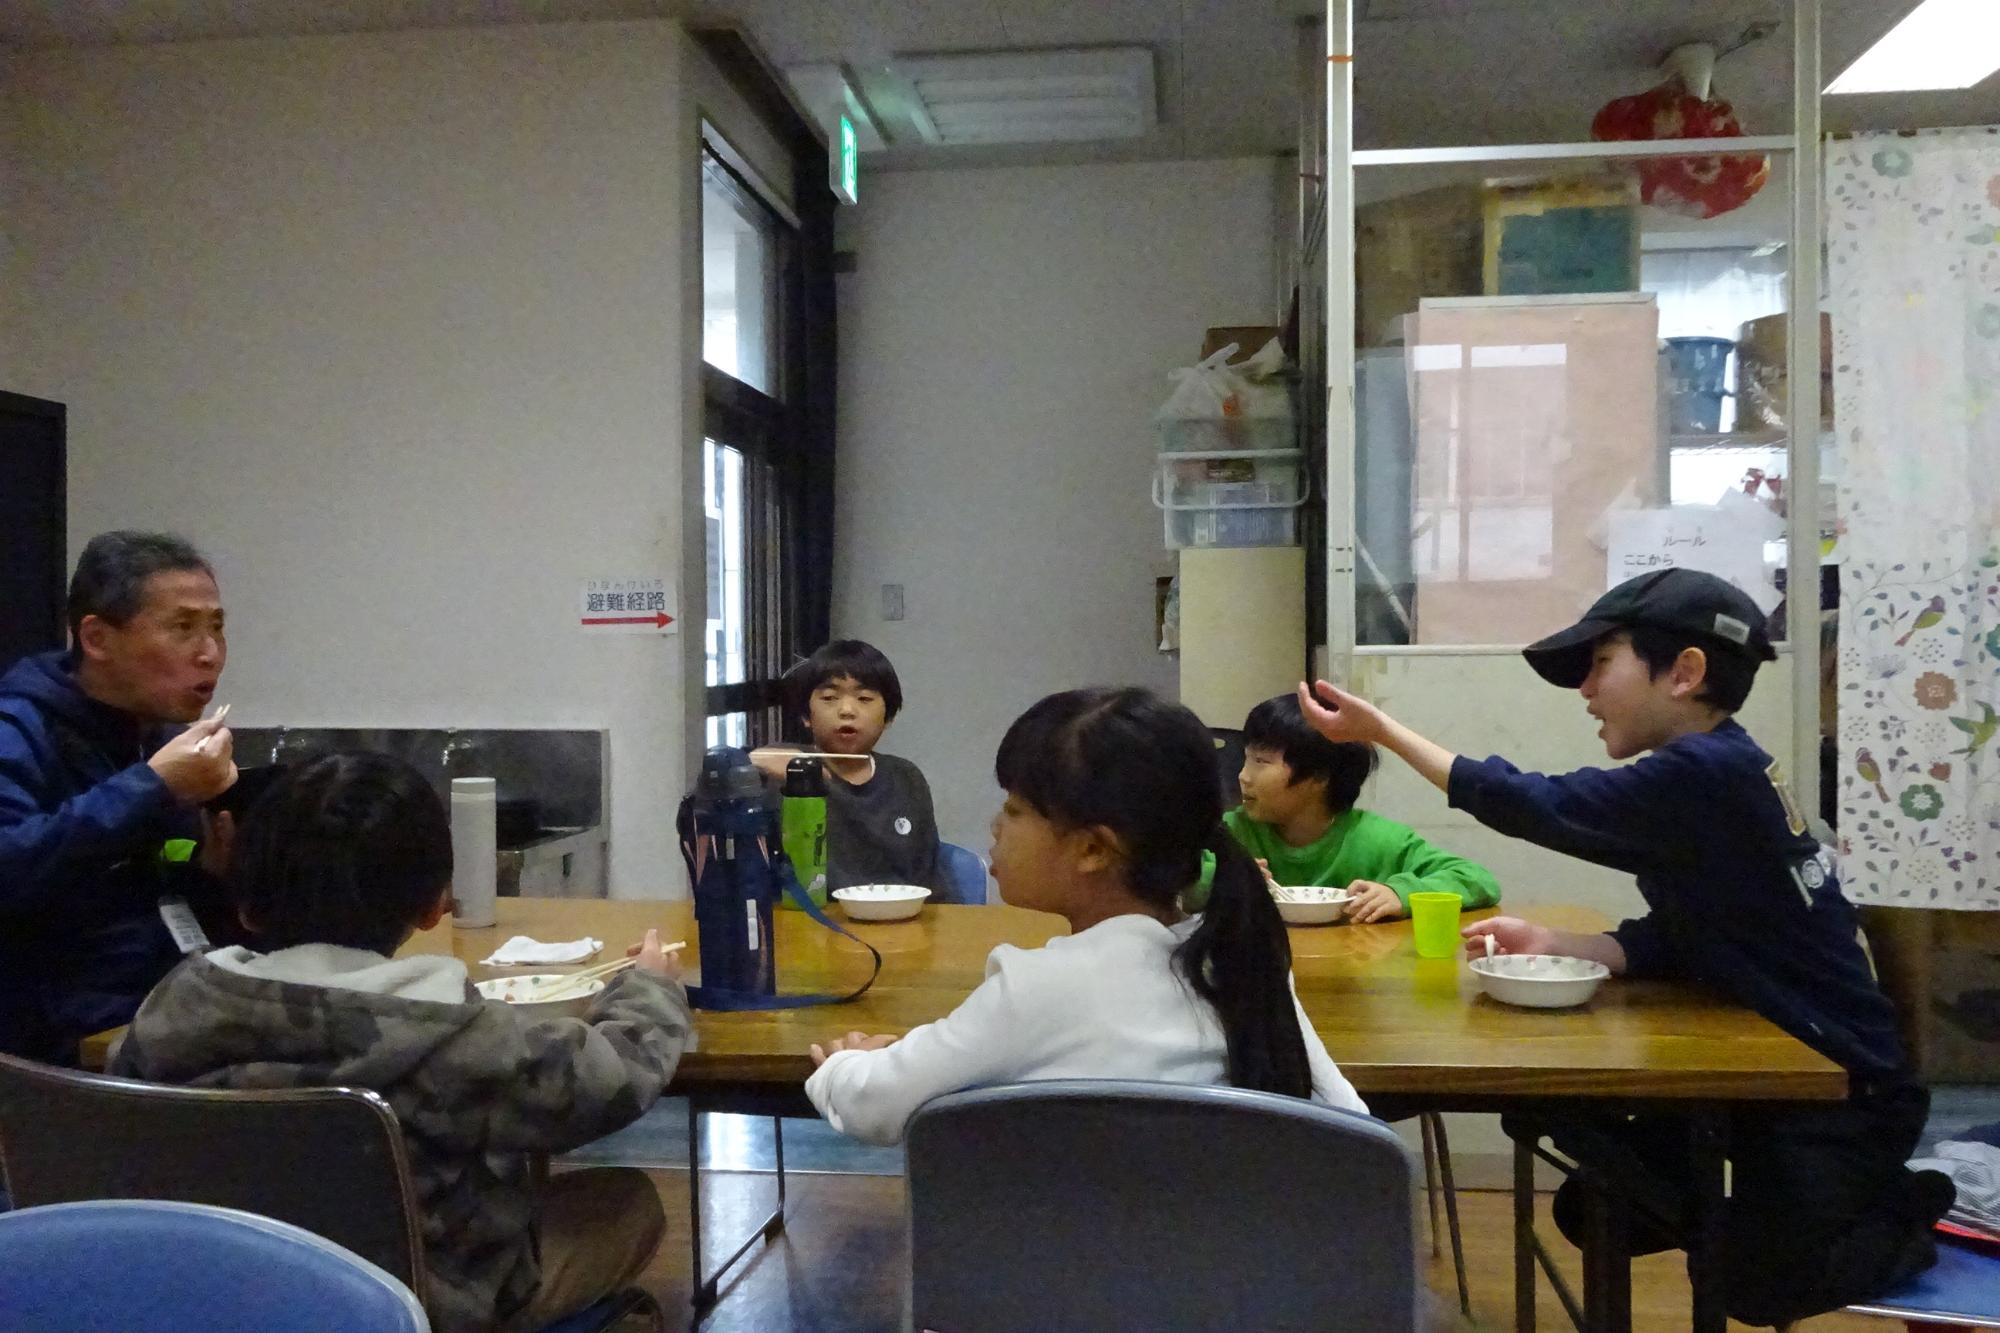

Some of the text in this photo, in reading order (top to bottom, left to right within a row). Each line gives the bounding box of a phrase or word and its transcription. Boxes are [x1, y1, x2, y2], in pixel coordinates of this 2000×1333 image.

[1663, 535, 1707, 547] ルール
[1624, 553, 1674, 566] ここから
[586, 592, 665, 611] 避難経路
